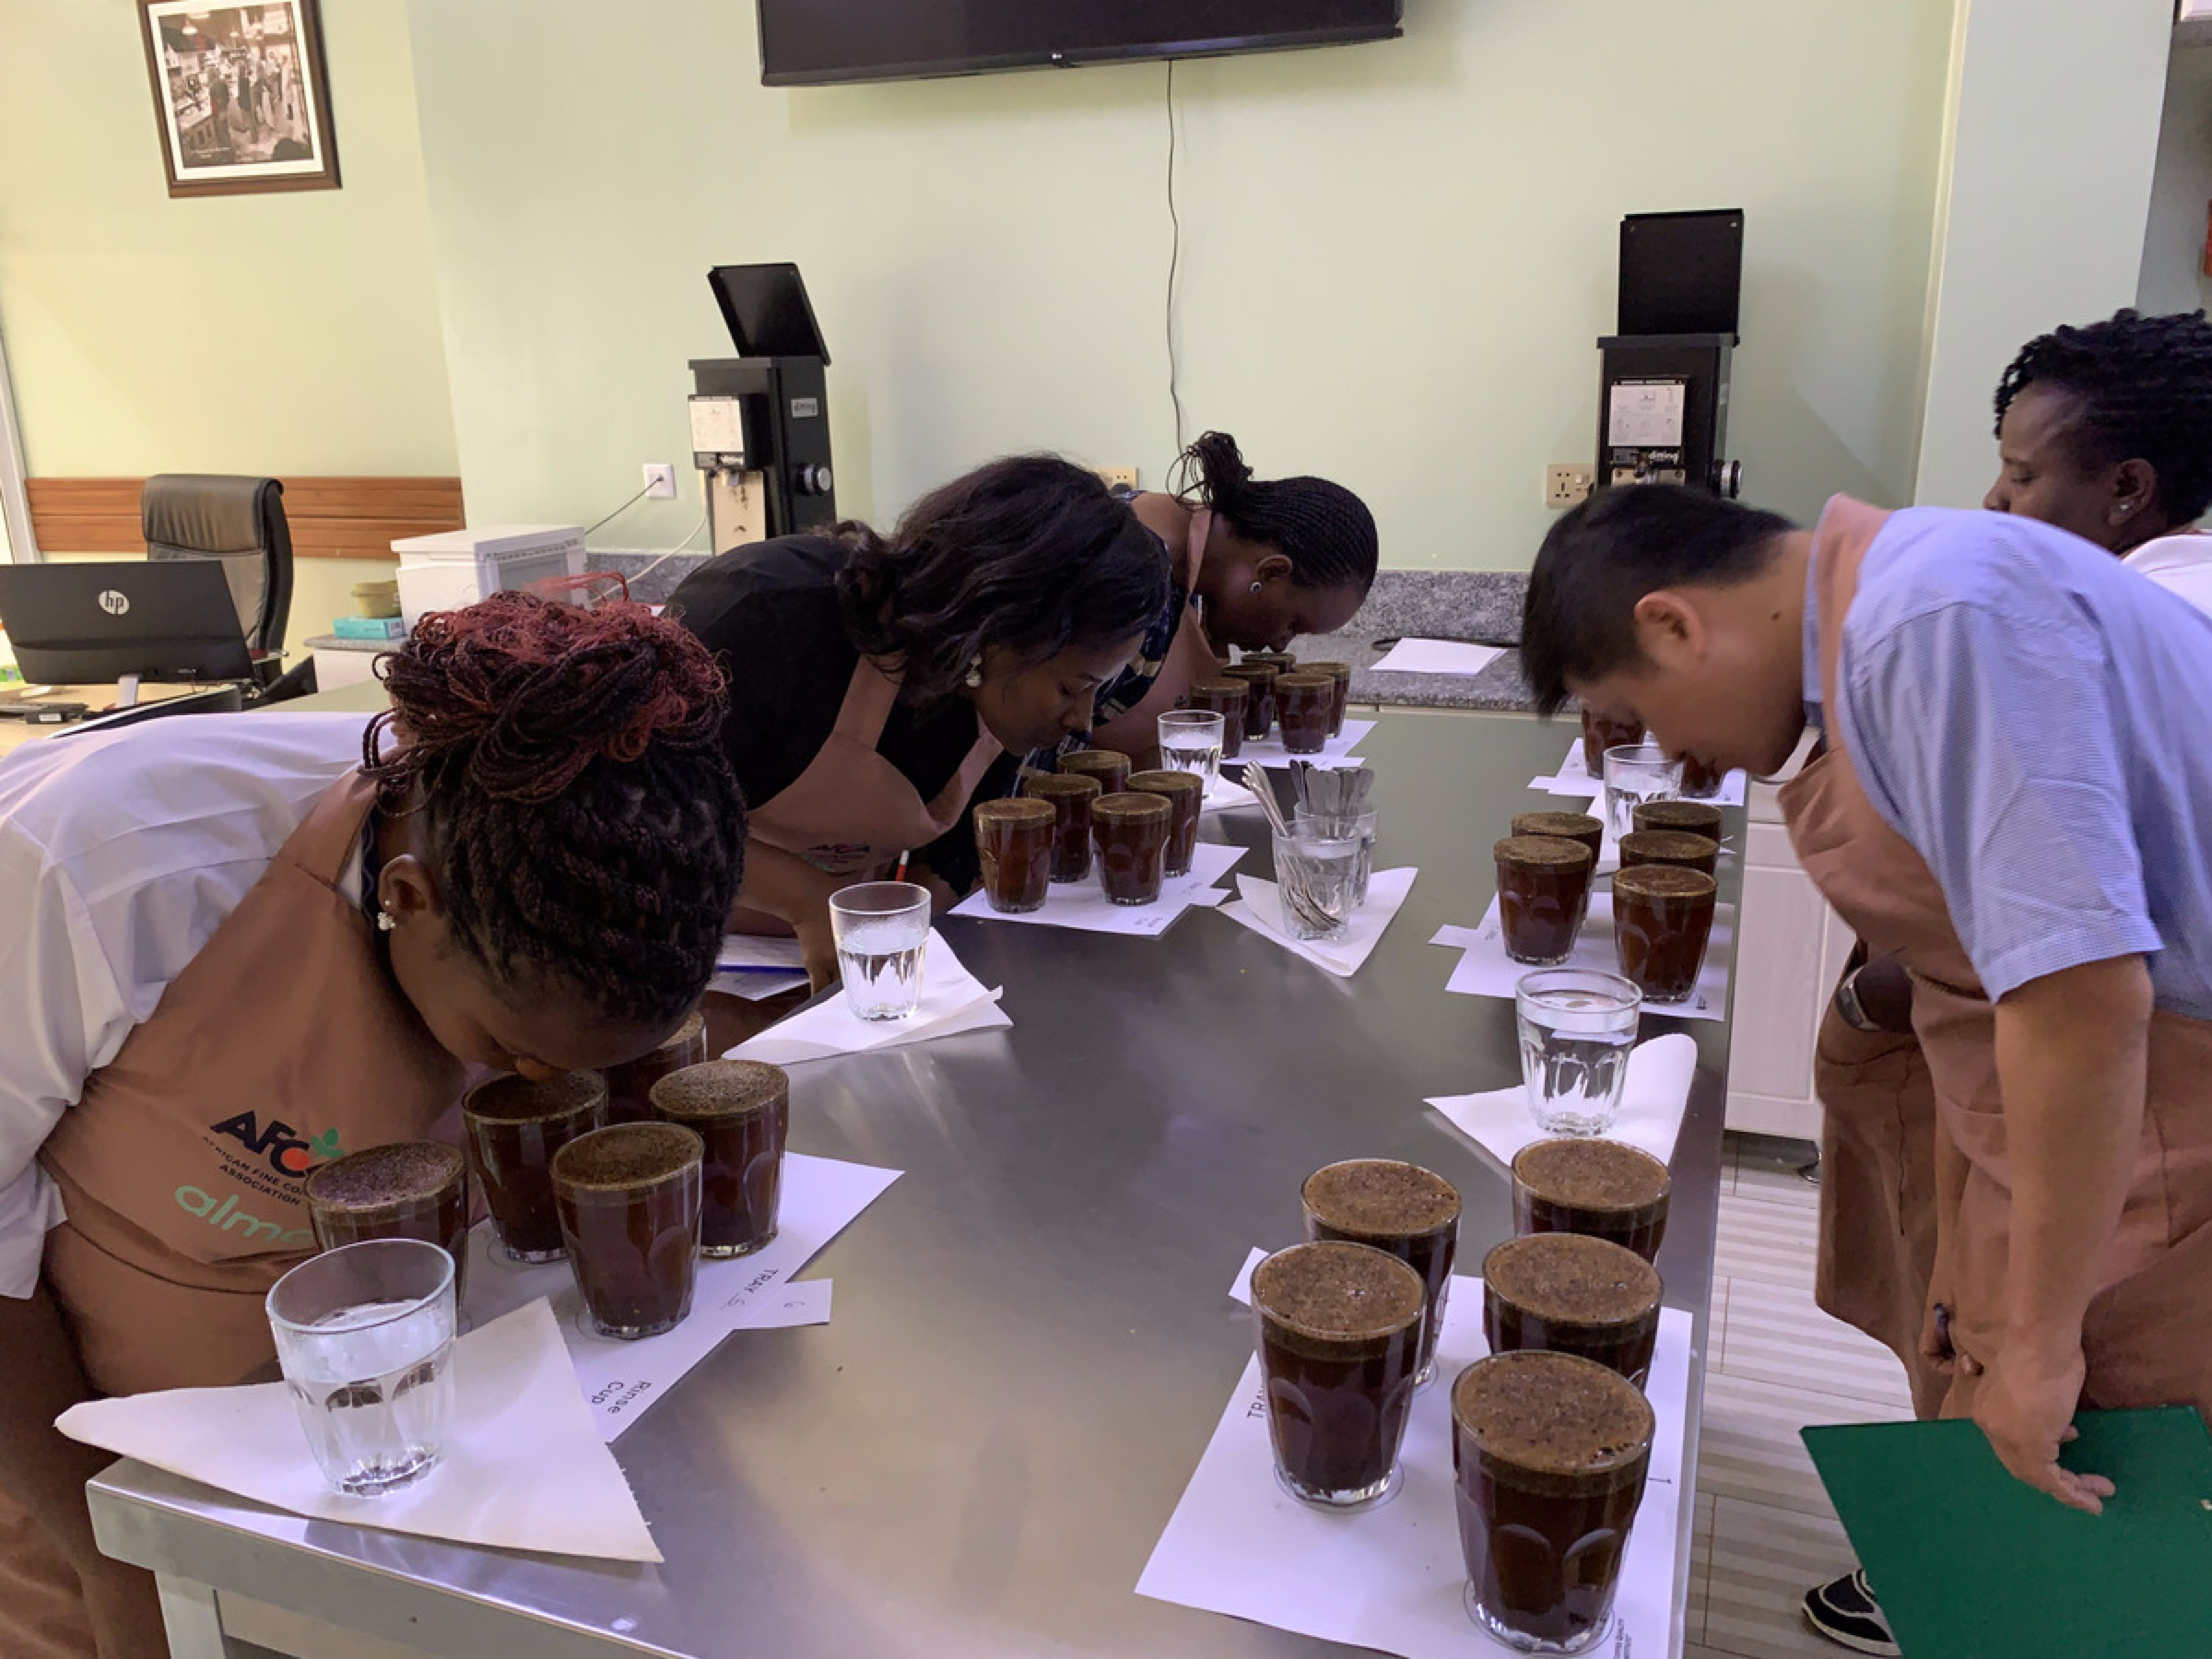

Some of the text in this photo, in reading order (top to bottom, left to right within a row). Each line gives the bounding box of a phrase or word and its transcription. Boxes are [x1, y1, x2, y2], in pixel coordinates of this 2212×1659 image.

[104, 589, 124, 615] hp
[210, 1109, 319, 1178] AFC
[219, 1164, 301, 1206] ASSOCIATION
[253, 1168, 280, 1185] FINE
[283, 1182, 303, 1195] CO
[744, 1269, 779, 1294] TRAY
[591, 1381, 625, 1405] Cup
[606, 1381, 651, 1414] Rinse
